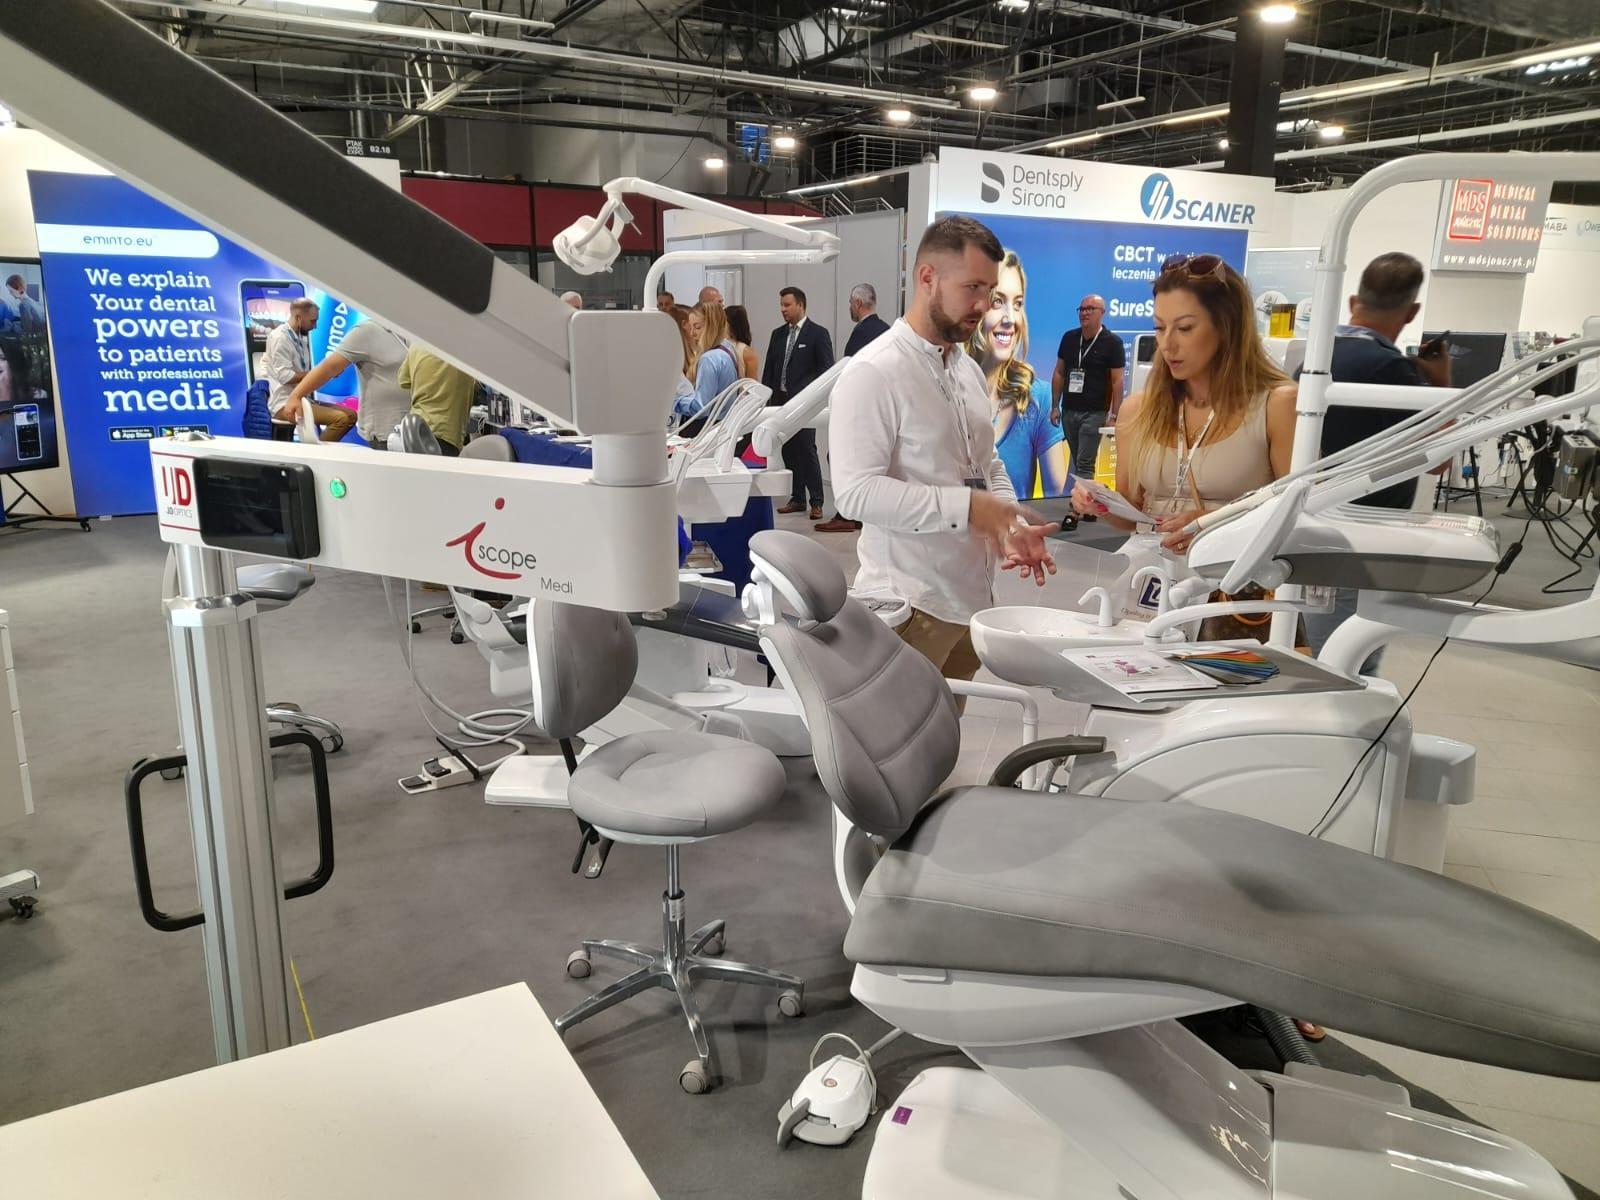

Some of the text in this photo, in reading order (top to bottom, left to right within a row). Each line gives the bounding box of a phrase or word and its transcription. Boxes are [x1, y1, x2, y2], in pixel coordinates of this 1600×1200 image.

[1013, 165, 1084, 192] Dentsply
[1012, 187, 1066, 209] Sirona
[1455, 188, 1487, 213] MDS
[1493, 183, 1537, 201] MEDICAL
[1173, 198, 1256, 225] SCANER
[1490, 204, 1527, 221] DENTAL
[1486, 224, 1541, 241] SOLUTIONS
[1114, 245, 1155, 263] CBCT
[84, 268, 212, 291] We explain
[1112, 266, 1155, 280] leczenia
[90, 293, 217, 312] Your dental
[92, 317, 220, 344] powers
[98, 345, 222, 366] to patients
[100, 367, 224, 382] with professional
[103, 382, 231, 412] media
[540, 576, 573, 595] Medi
